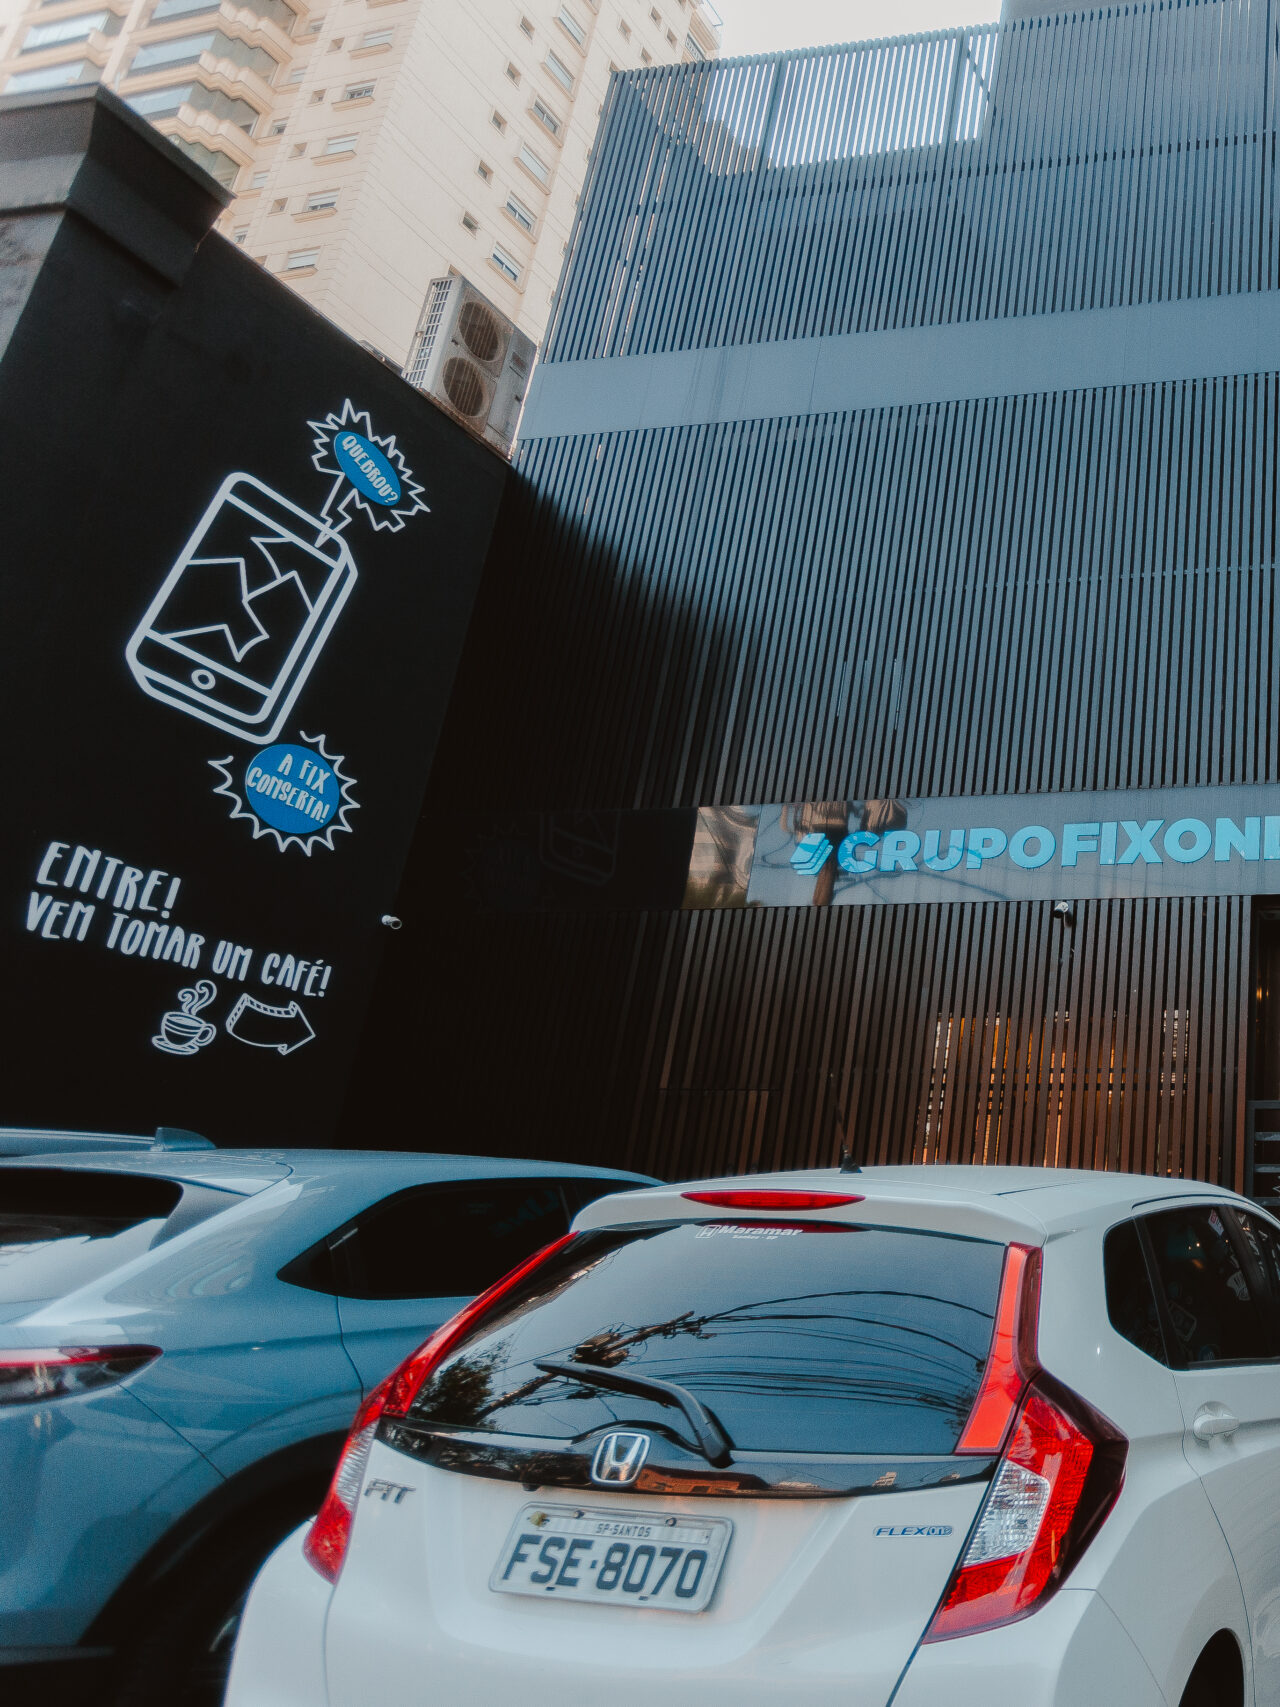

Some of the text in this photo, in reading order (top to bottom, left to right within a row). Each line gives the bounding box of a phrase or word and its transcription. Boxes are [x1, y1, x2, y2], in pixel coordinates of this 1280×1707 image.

[342, 435, 398, 503] QUEBROU?
[247, 766, 331, 824] CONSERTA!
[277, 753, 332, 795] A FIX
[36, 841, 182, 918] ENTRE!
[26, 891, 332, 998] VEM TOMAR UM CAFÉ!
[363, 1478, 417, 1504] FIT
